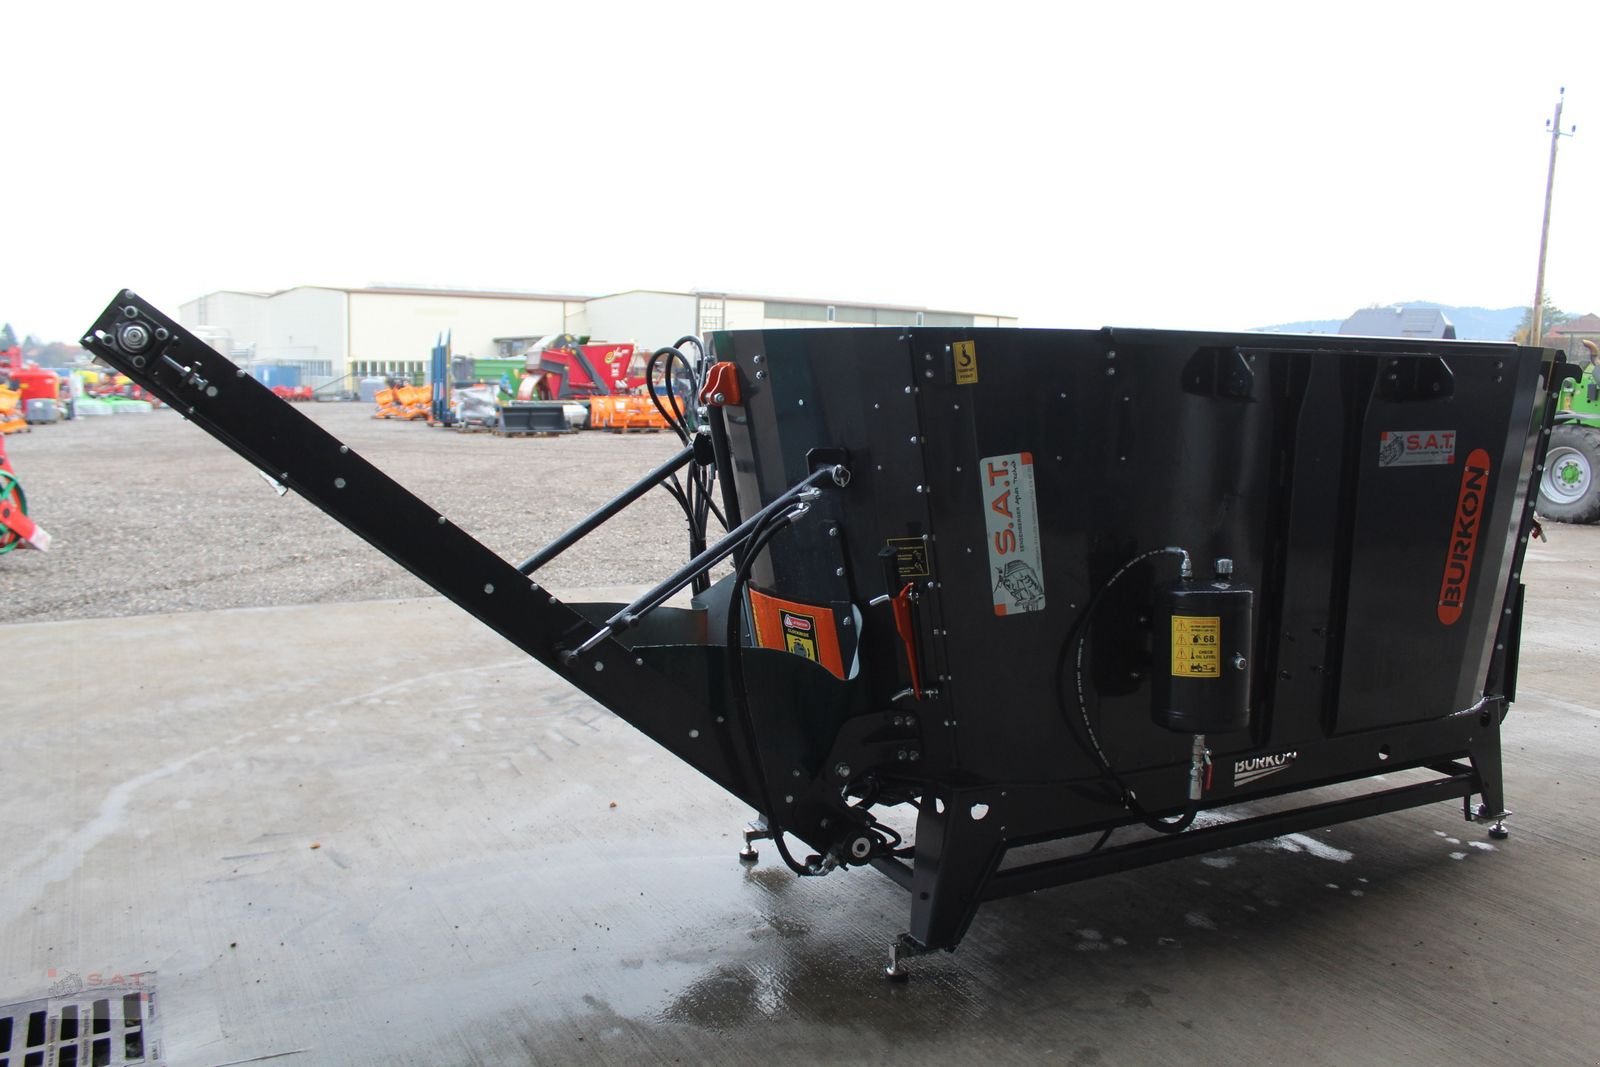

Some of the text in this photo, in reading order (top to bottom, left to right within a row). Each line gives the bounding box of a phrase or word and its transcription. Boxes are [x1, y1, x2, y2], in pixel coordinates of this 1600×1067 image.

[1407, 432, 1454, 450] S.A.T.
[988, 459, 1016, 555] S.A.T.
[1442, 466, 1485, 608] BURKON
[1203, 635, 1215, 643] 68
